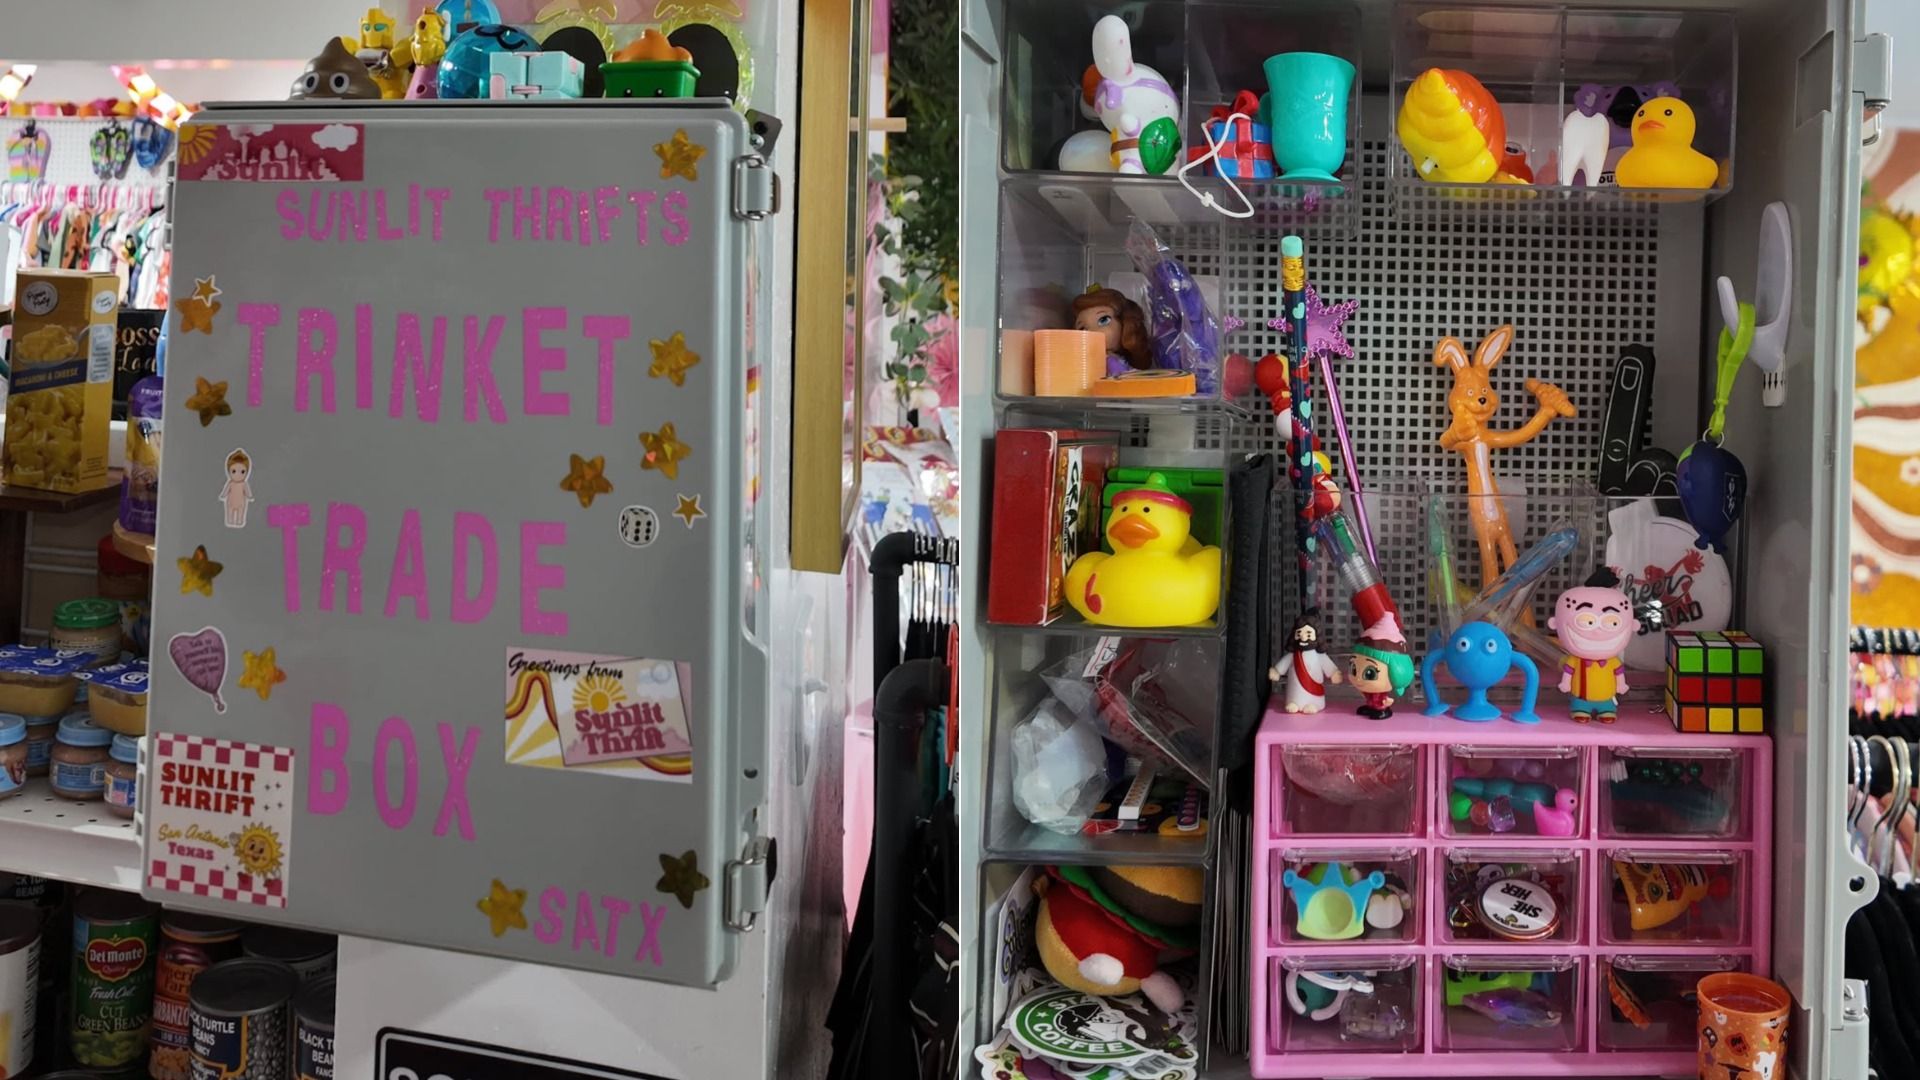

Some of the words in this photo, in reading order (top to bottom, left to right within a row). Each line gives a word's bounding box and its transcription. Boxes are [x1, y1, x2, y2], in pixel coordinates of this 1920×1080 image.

[217, 150, 327, 181] Sunlit
[277, 184, 450, 241] SUNLIT
[485, 187, 690, 245] THRIFTS
[117, 327, 160, 346] OSS
[238, 303, 630, 425] TRINKET
[267, 503, 568, 635] TRADE
[1620, 574, 1693, 605] heer
[508, 652, 581, 681] Greetings
[586, 660, 624, 682] from
[575, 702, 665, 733] Sunlit
[582, 725, 666, 755] Thrift
[161, 761, 255, 793] SUNLIT
[308, 703, 480, 840] BOX
[160, 784, 255, 817] THRIFT
[158, 823, 182, 841] San
[185, 823, 230, 848] Antonio
[168, 841, 214, 860] Texas
[1501, 883, 1532, 900] HER
[1510, 900, 1543, 918] SHE
[534, 886, 667, 965] SATX
[90, 949, 106, 963] Del
[107, 948, 143, 963] Monte
[89, 986, 115, 999] Fresh
[115, 985, 137, 998] Cut
[78, 1014, 111, 1031] GREEN
[100, 1005, 125, 1018] CUT
[192, 1025, 216, 1046] BEANS
[202, 1017, 236, 1034] TURTLE
[299, 1027, 324, 1047] BLACK
[1033, 1023, 1127, 1053] COFFEE
[315, 1065, 334, 1078] FANC
